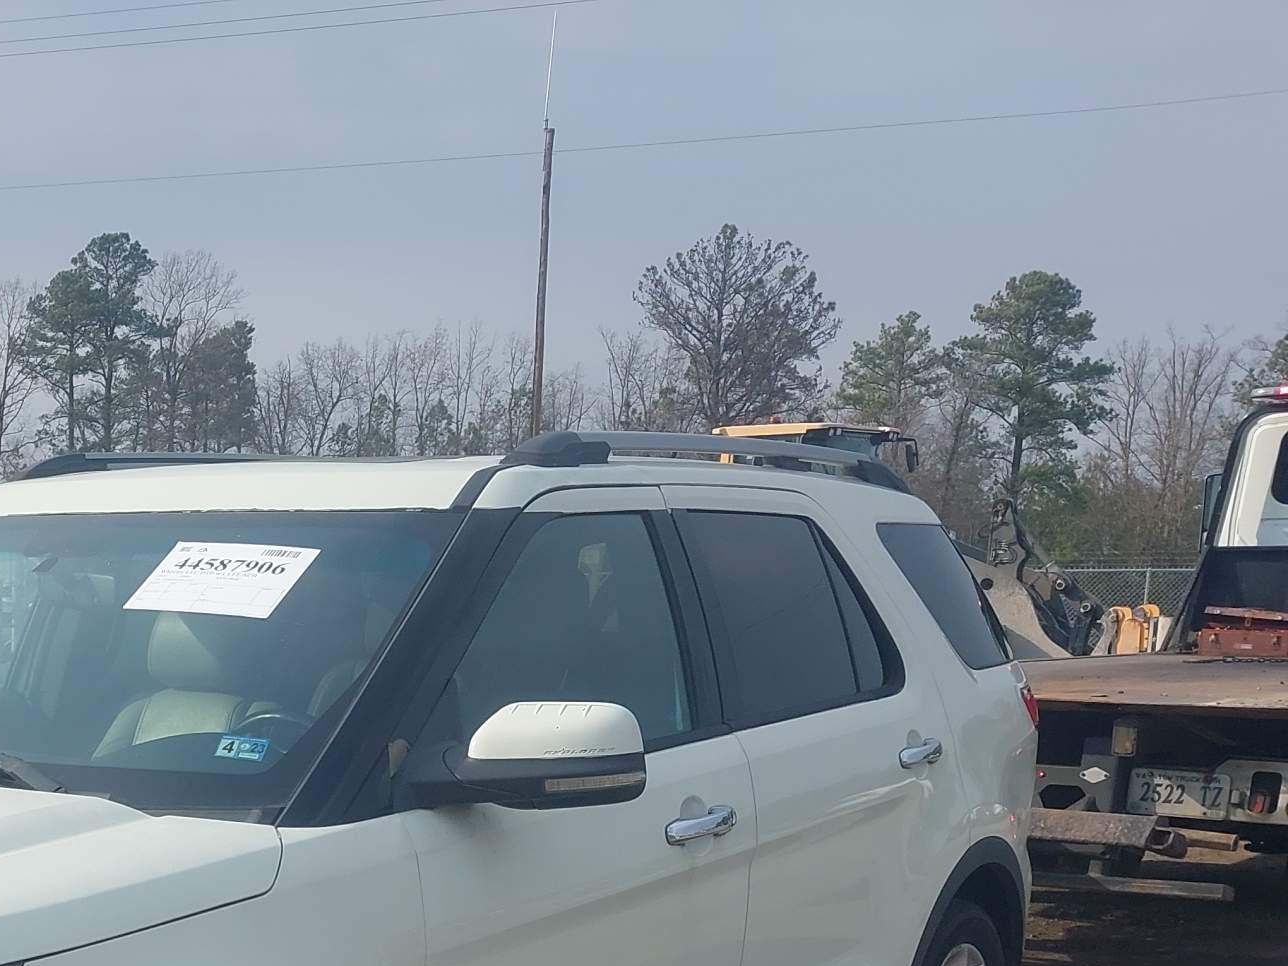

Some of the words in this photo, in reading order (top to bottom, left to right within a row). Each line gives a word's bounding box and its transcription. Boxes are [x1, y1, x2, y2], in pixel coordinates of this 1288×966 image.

[174, 558, 289, 575] 44587906
[222, 741, 235, 753] 4
[1139, 781, 1186, 804] 2522
[1200, 786, 1224, 807] TZ
